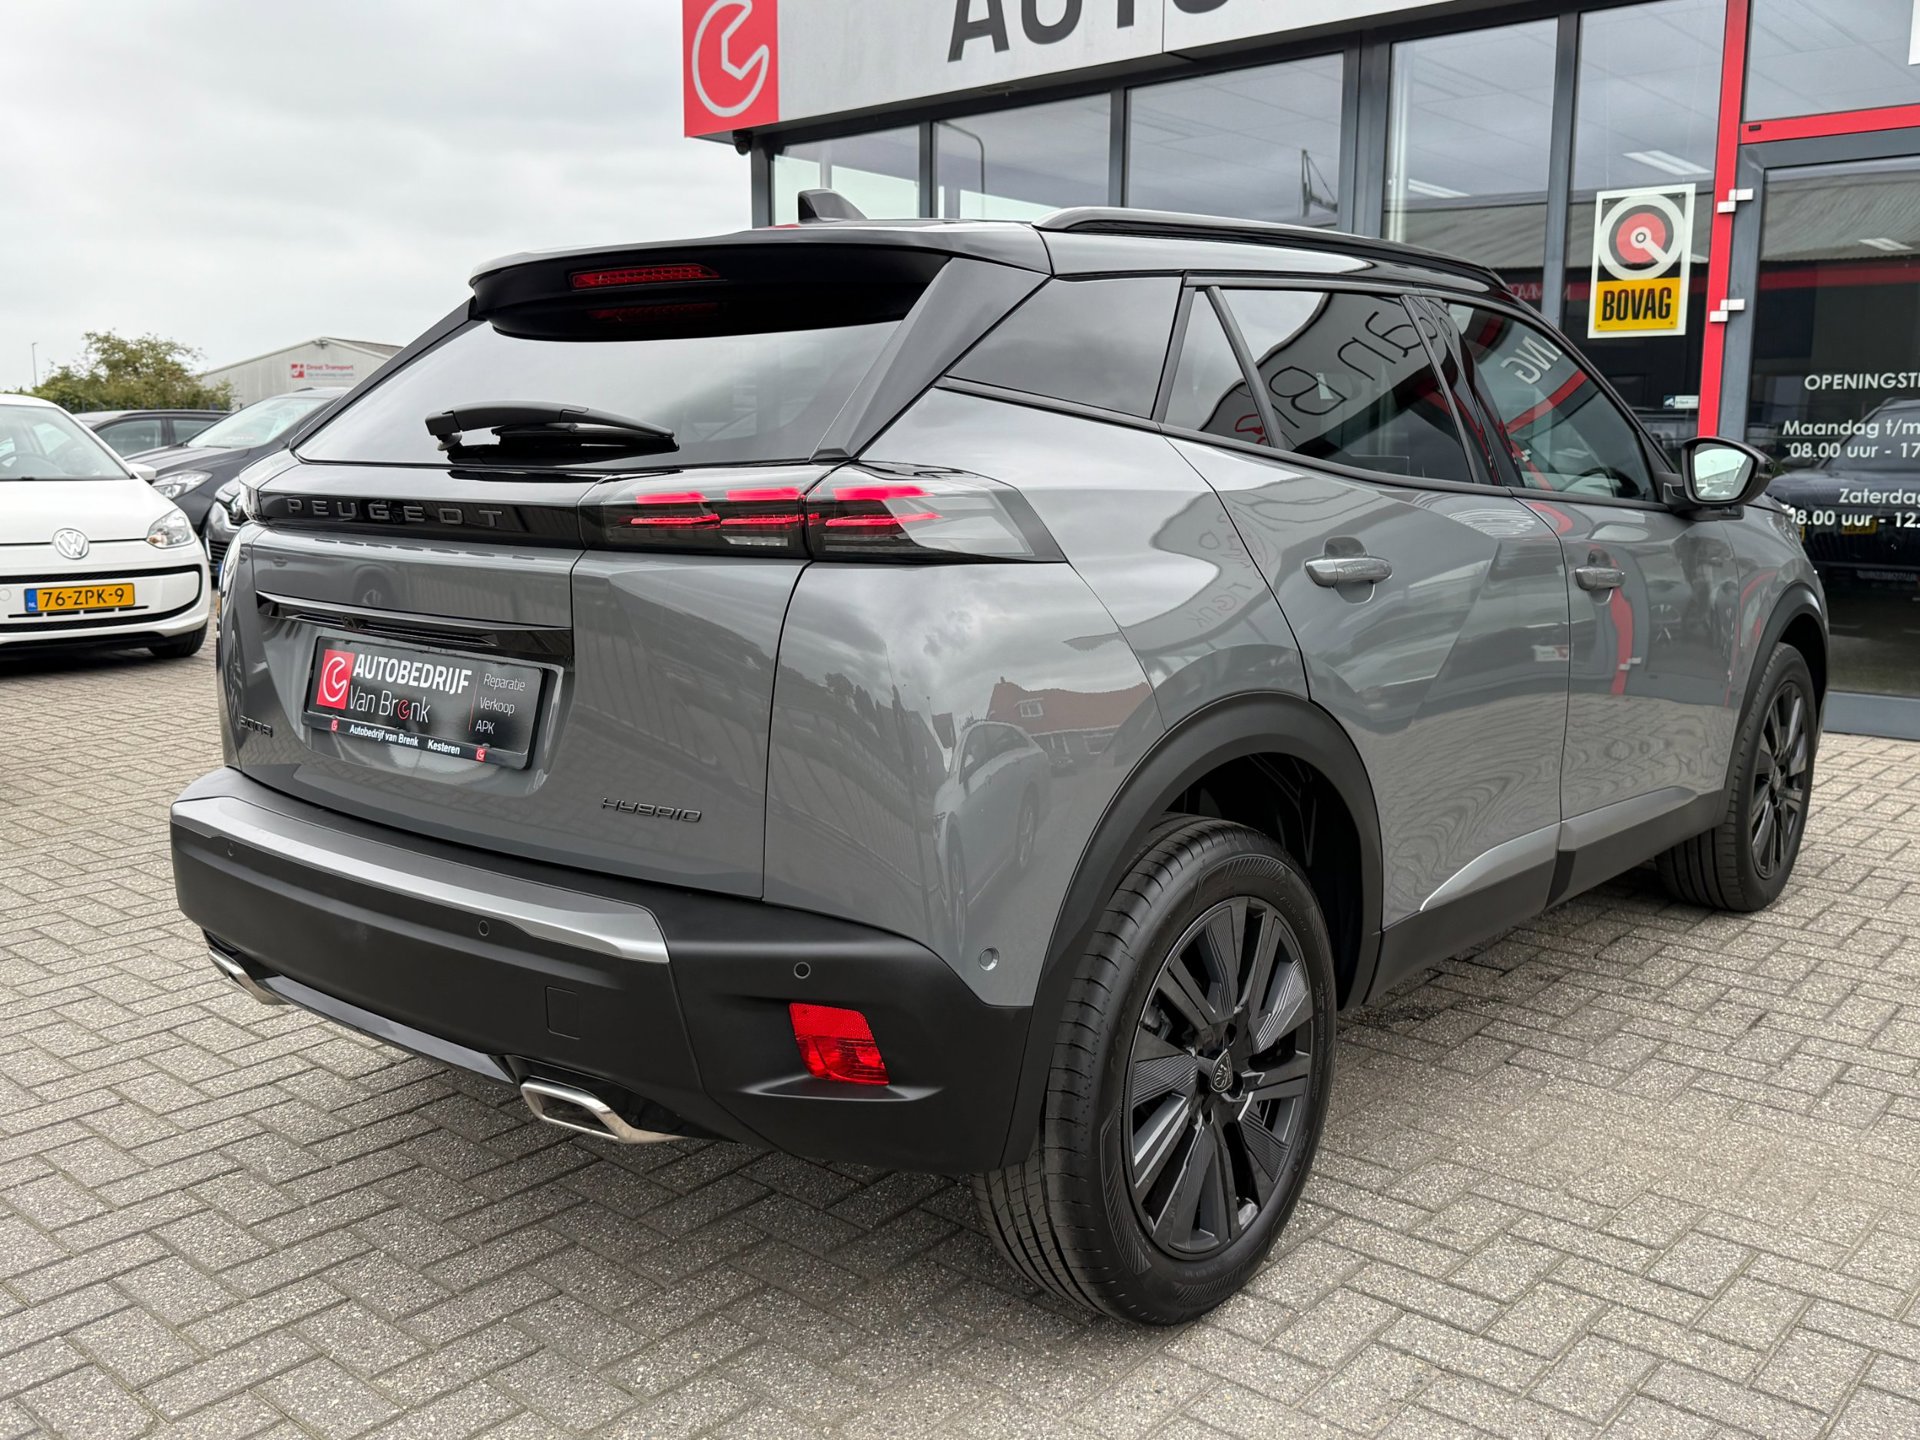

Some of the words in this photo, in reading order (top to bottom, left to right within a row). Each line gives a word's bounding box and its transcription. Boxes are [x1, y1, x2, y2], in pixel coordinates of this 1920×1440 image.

[947, 0, 1231, 62] AU
[1601, 287, 1672, 321] BOVAG
[1782, 420, 1880, 438] Maandag
[1885, 419, 1920, 437] t/m
[1790, 442, 1841, 458] 08.00
[1846, 446, 1879, 458] uur
[287, 499, 502, 528] PEUGEOT
[1841, 513, 1872, 526] uur
[42, 588, 125, 608] 76-ZPK-9
[352, 654, 472, 695] AUTOBEDRIJF
[483, 673, 525, 691] Reparatie
[350, 685, 376, 713] Van
[480, 697, 515, 716] Verkoop
[475, 720, 495, 735] APK
[349, 724, 384, 742] Autobedrijf
[385, 732, 398, 743] van
[398, 733, 419, 747] Brenk
[427, 739, 461, 755] Kesteren
[602, 798, 702, 822] HYBRID
